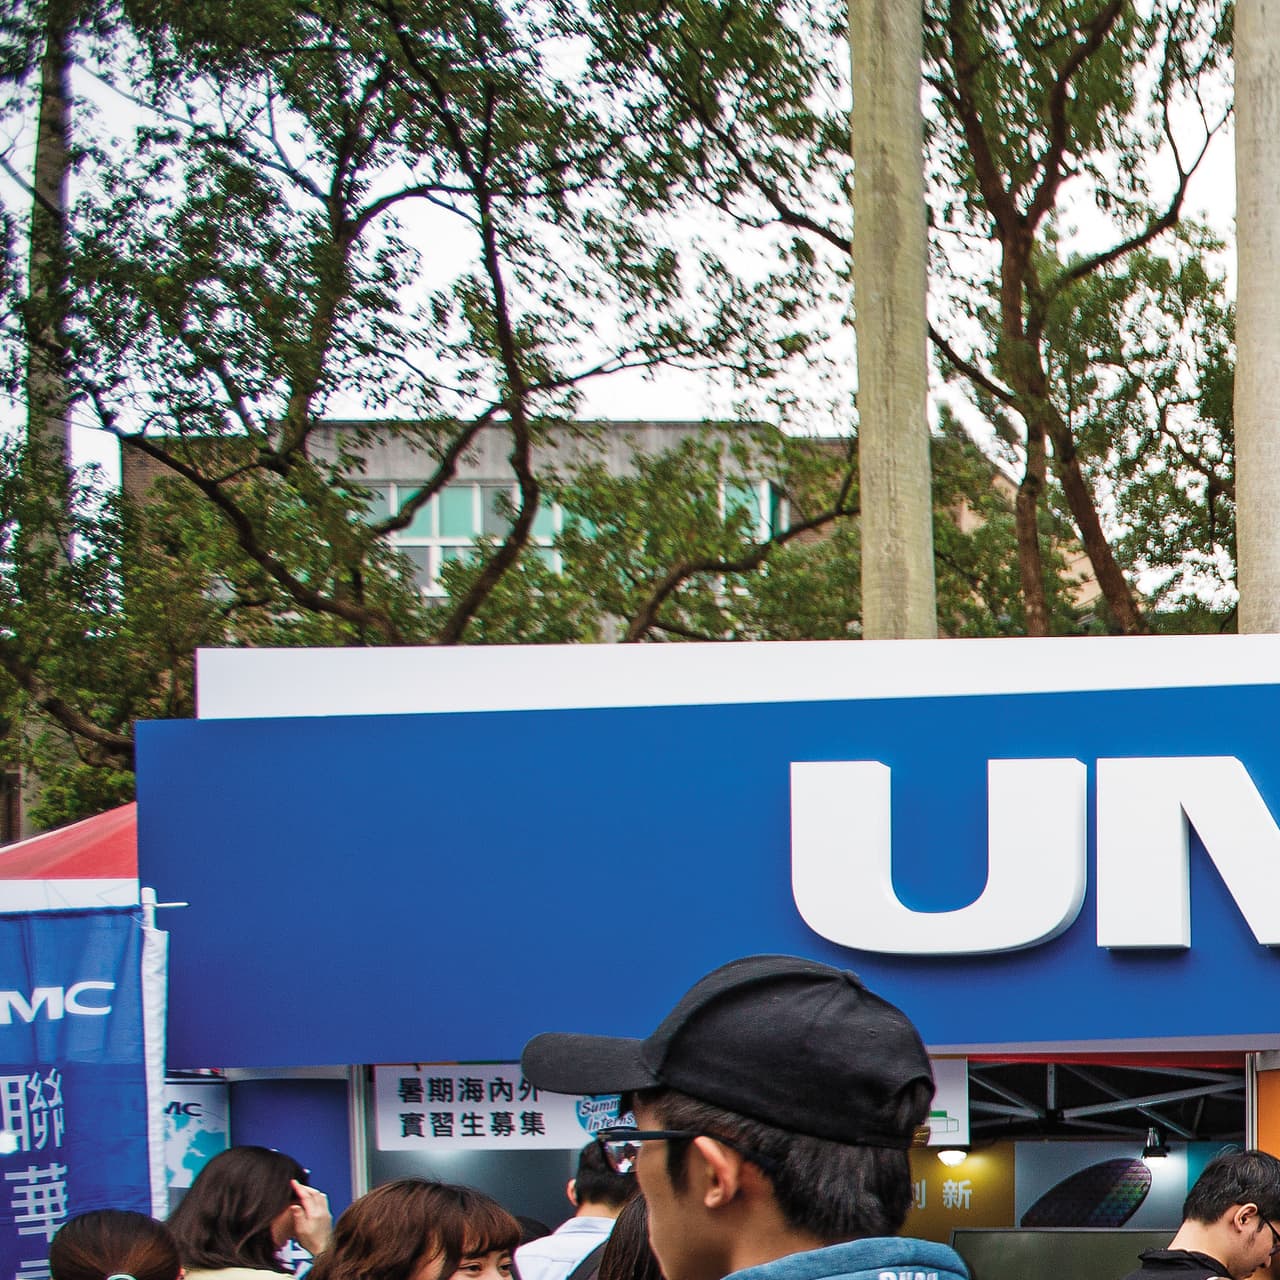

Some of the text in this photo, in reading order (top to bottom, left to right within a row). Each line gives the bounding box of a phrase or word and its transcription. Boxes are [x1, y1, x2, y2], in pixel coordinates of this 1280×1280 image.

[399, 1111, 546, 1138] 實習生募集
